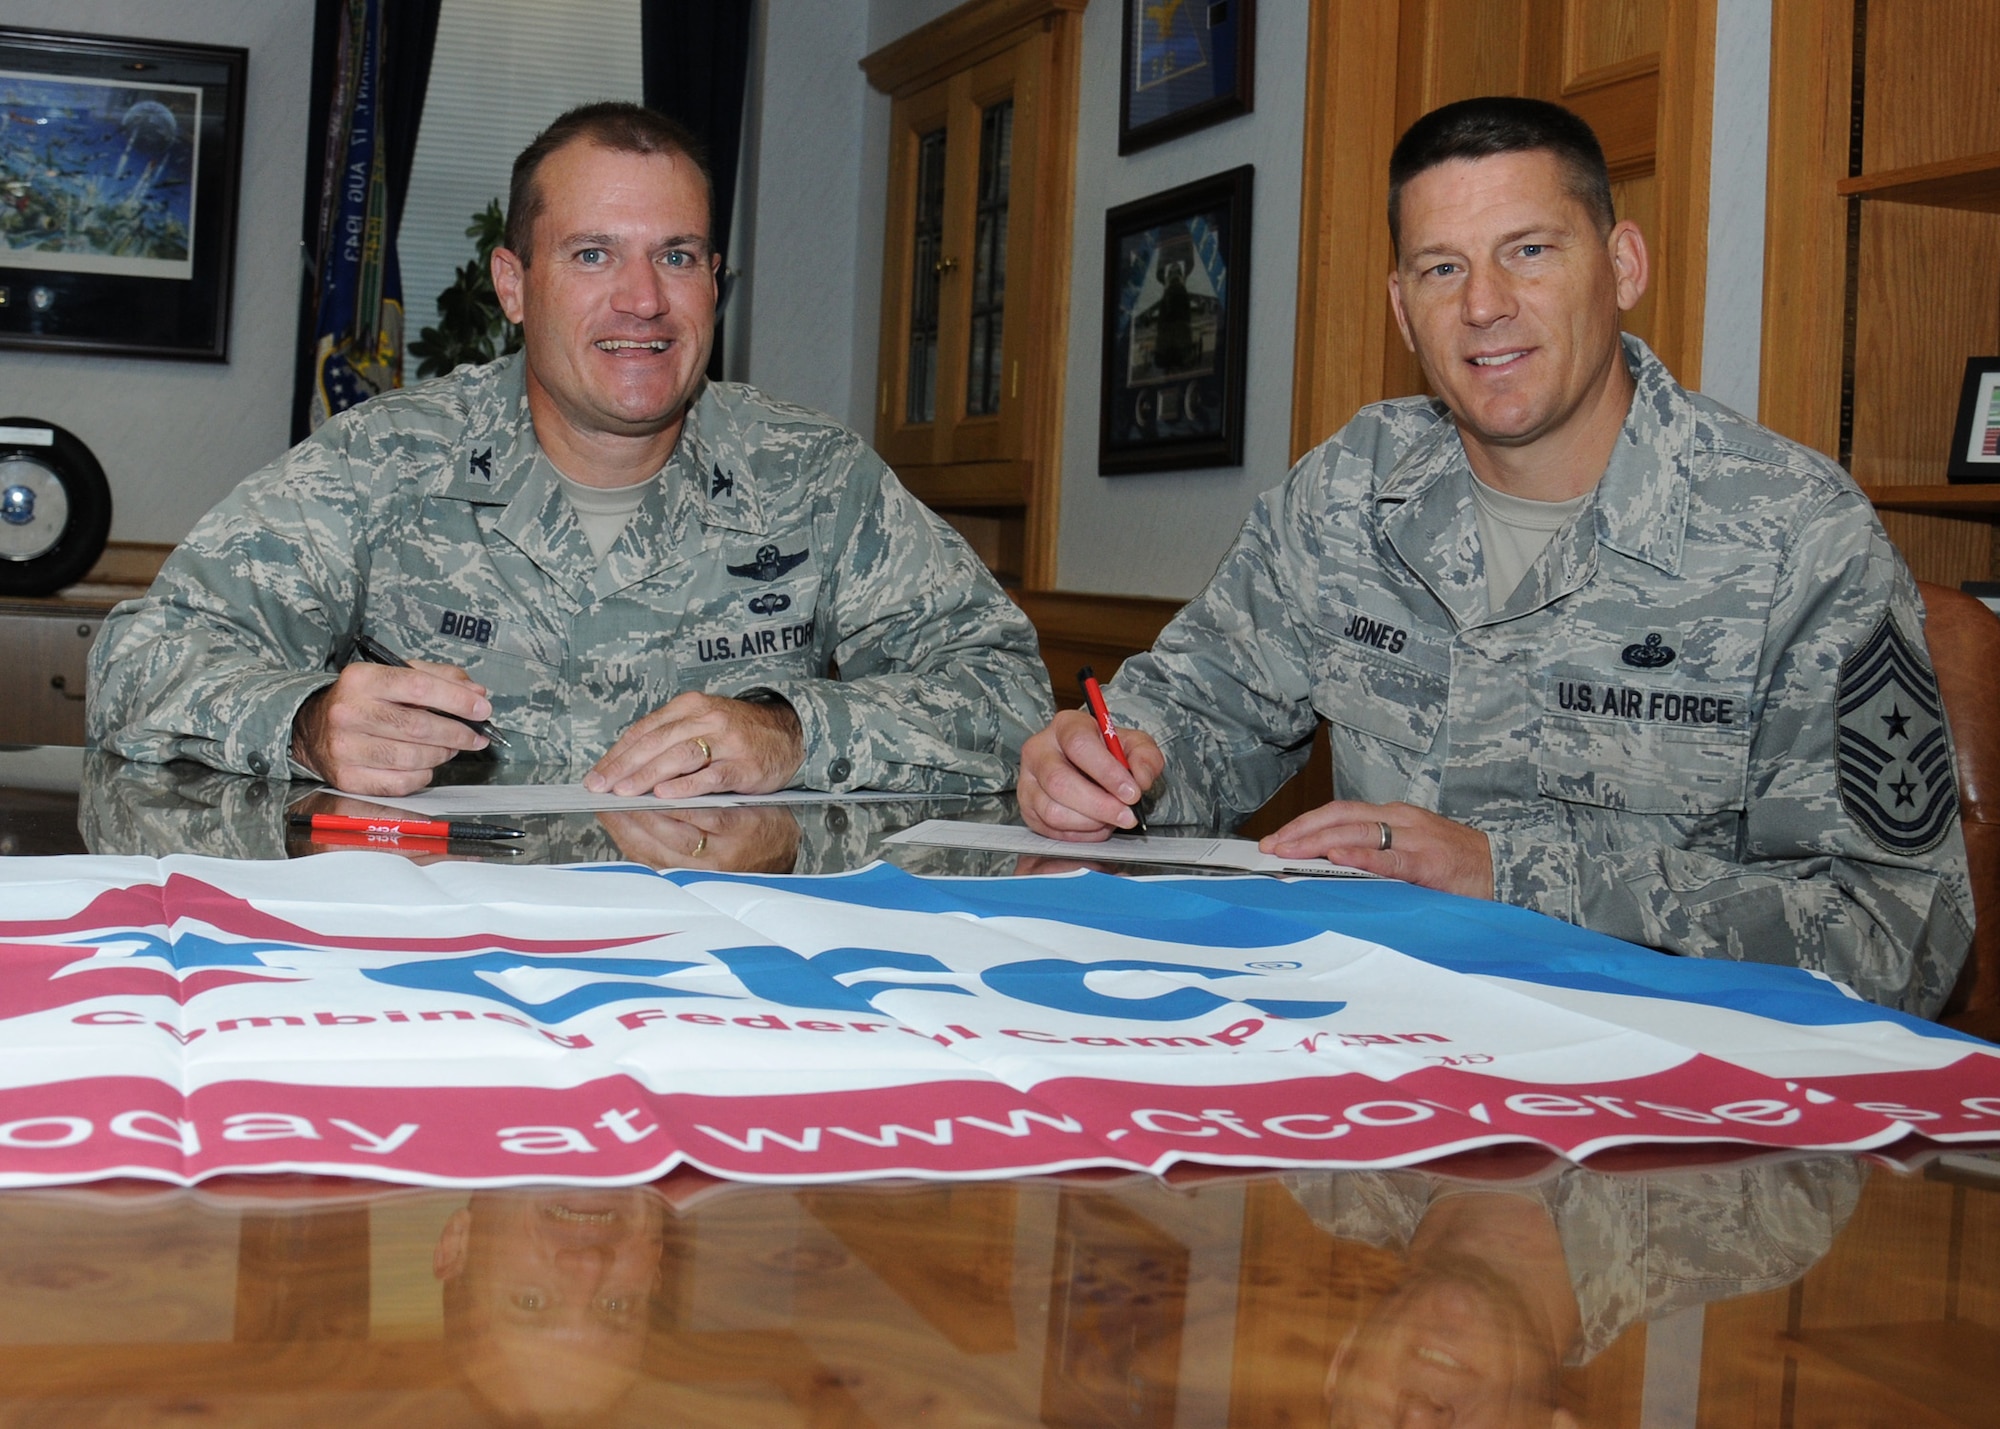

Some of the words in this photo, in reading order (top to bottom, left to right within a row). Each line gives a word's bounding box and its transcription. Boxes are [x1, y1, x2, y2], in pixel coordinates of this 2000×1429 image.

[439, 610, 493, 644] BIBB
[698, 637, 736, 662] U.S.
[741, 630, 777, 657] AIR
[781, 622, 815, 650] FOR
[1344, 614, 1407, 654] JONES
[1558, 682, 1596, 713] U.S.
[1602, 688, 1642, 719] AIR
[1648, 692, 1734, 724] FORCE
[1000, 1013, 1453, 1054] Campn
[496, 1107, 659, 1155] at
